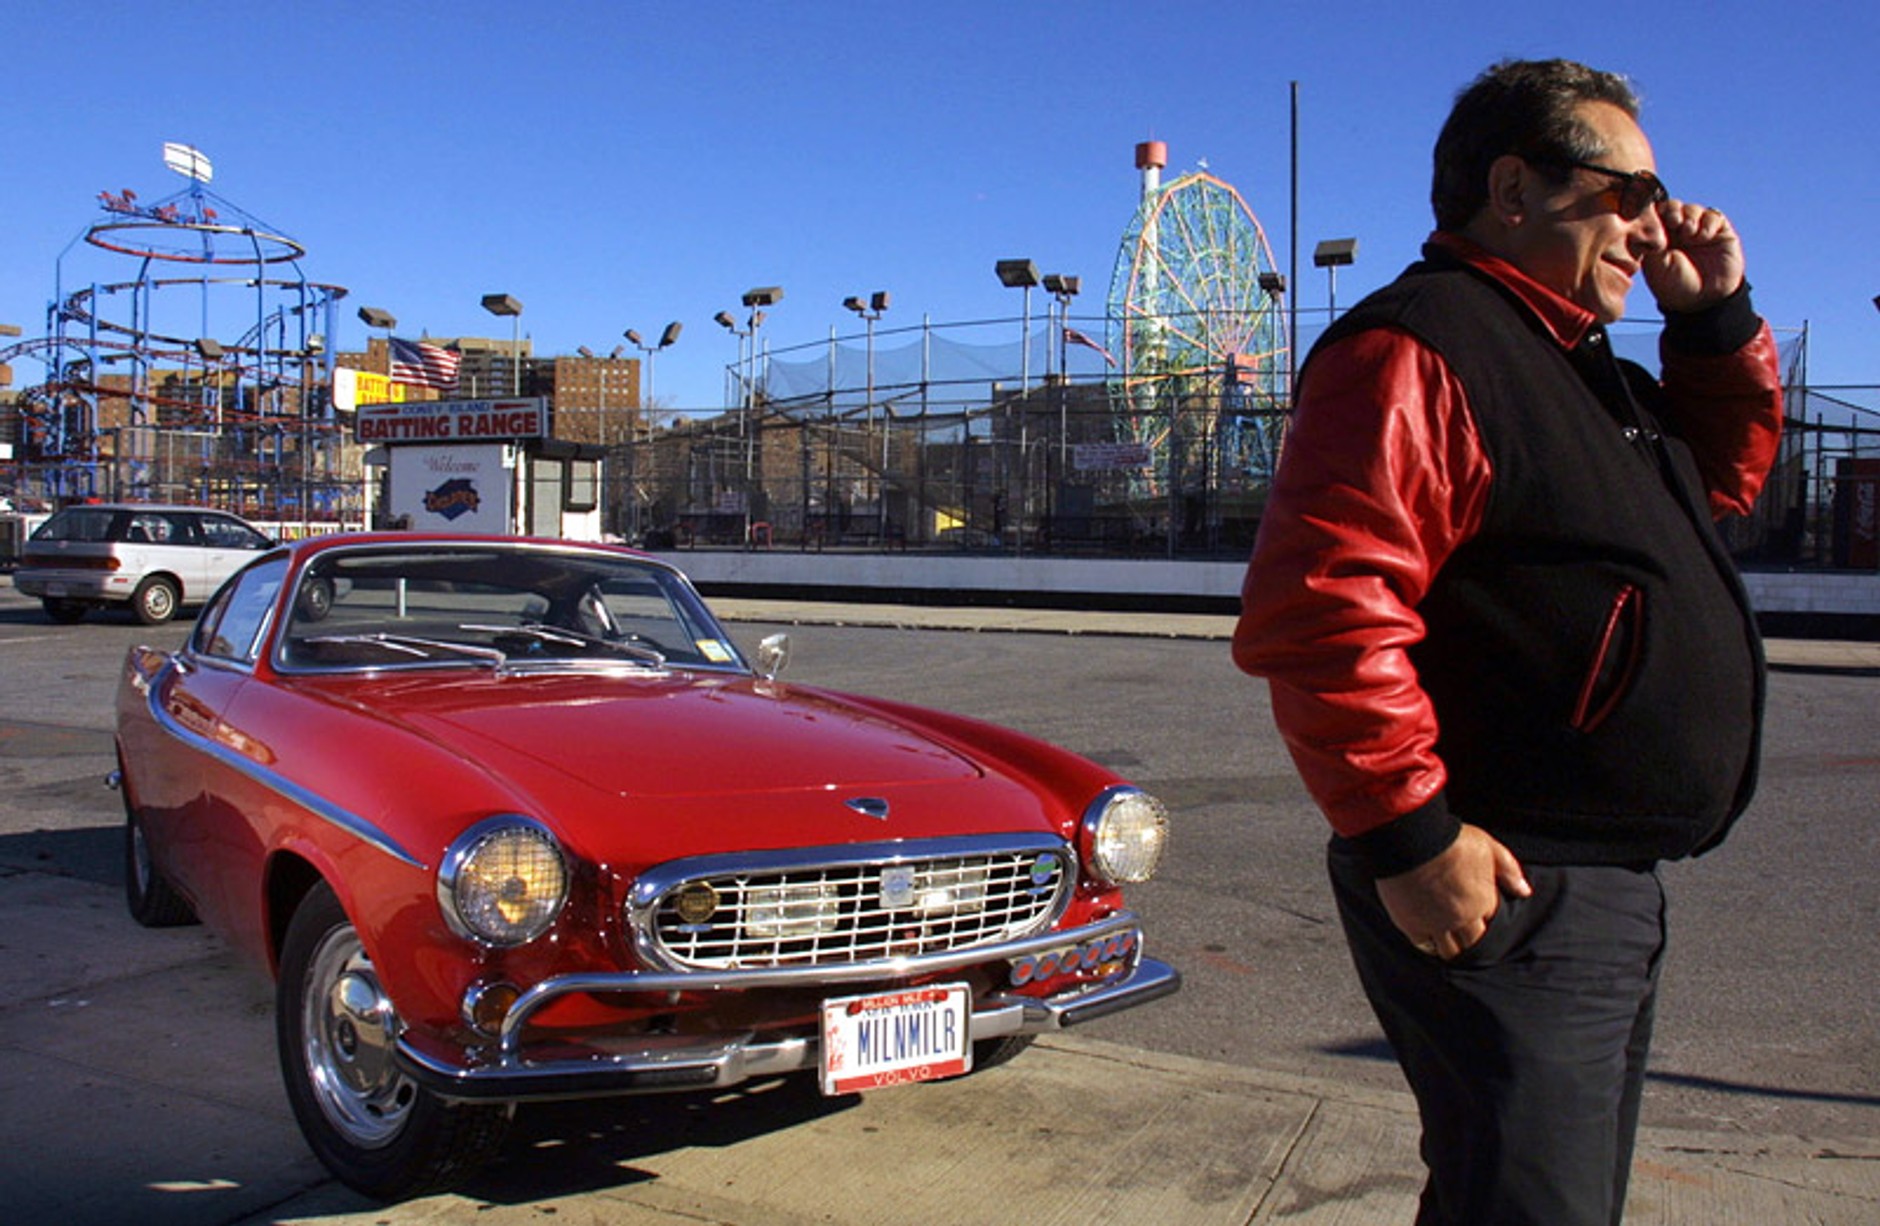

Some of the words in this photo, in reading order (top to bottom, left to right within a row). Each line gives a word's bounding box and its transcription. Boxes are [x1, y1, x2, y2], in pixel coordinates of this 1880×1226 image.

[402, 403, 442, 415] CONEY
[448, 401, 491, 412] ISLAND
[360, 415, 450, 438] BATTING
[457, 411, 537, 435] RANGE
[426, 455, 480, 472] Welcome
[858, 1007, 956, 1067] MILNMILR
[873, 1066, 932, 1086] VOLVO
